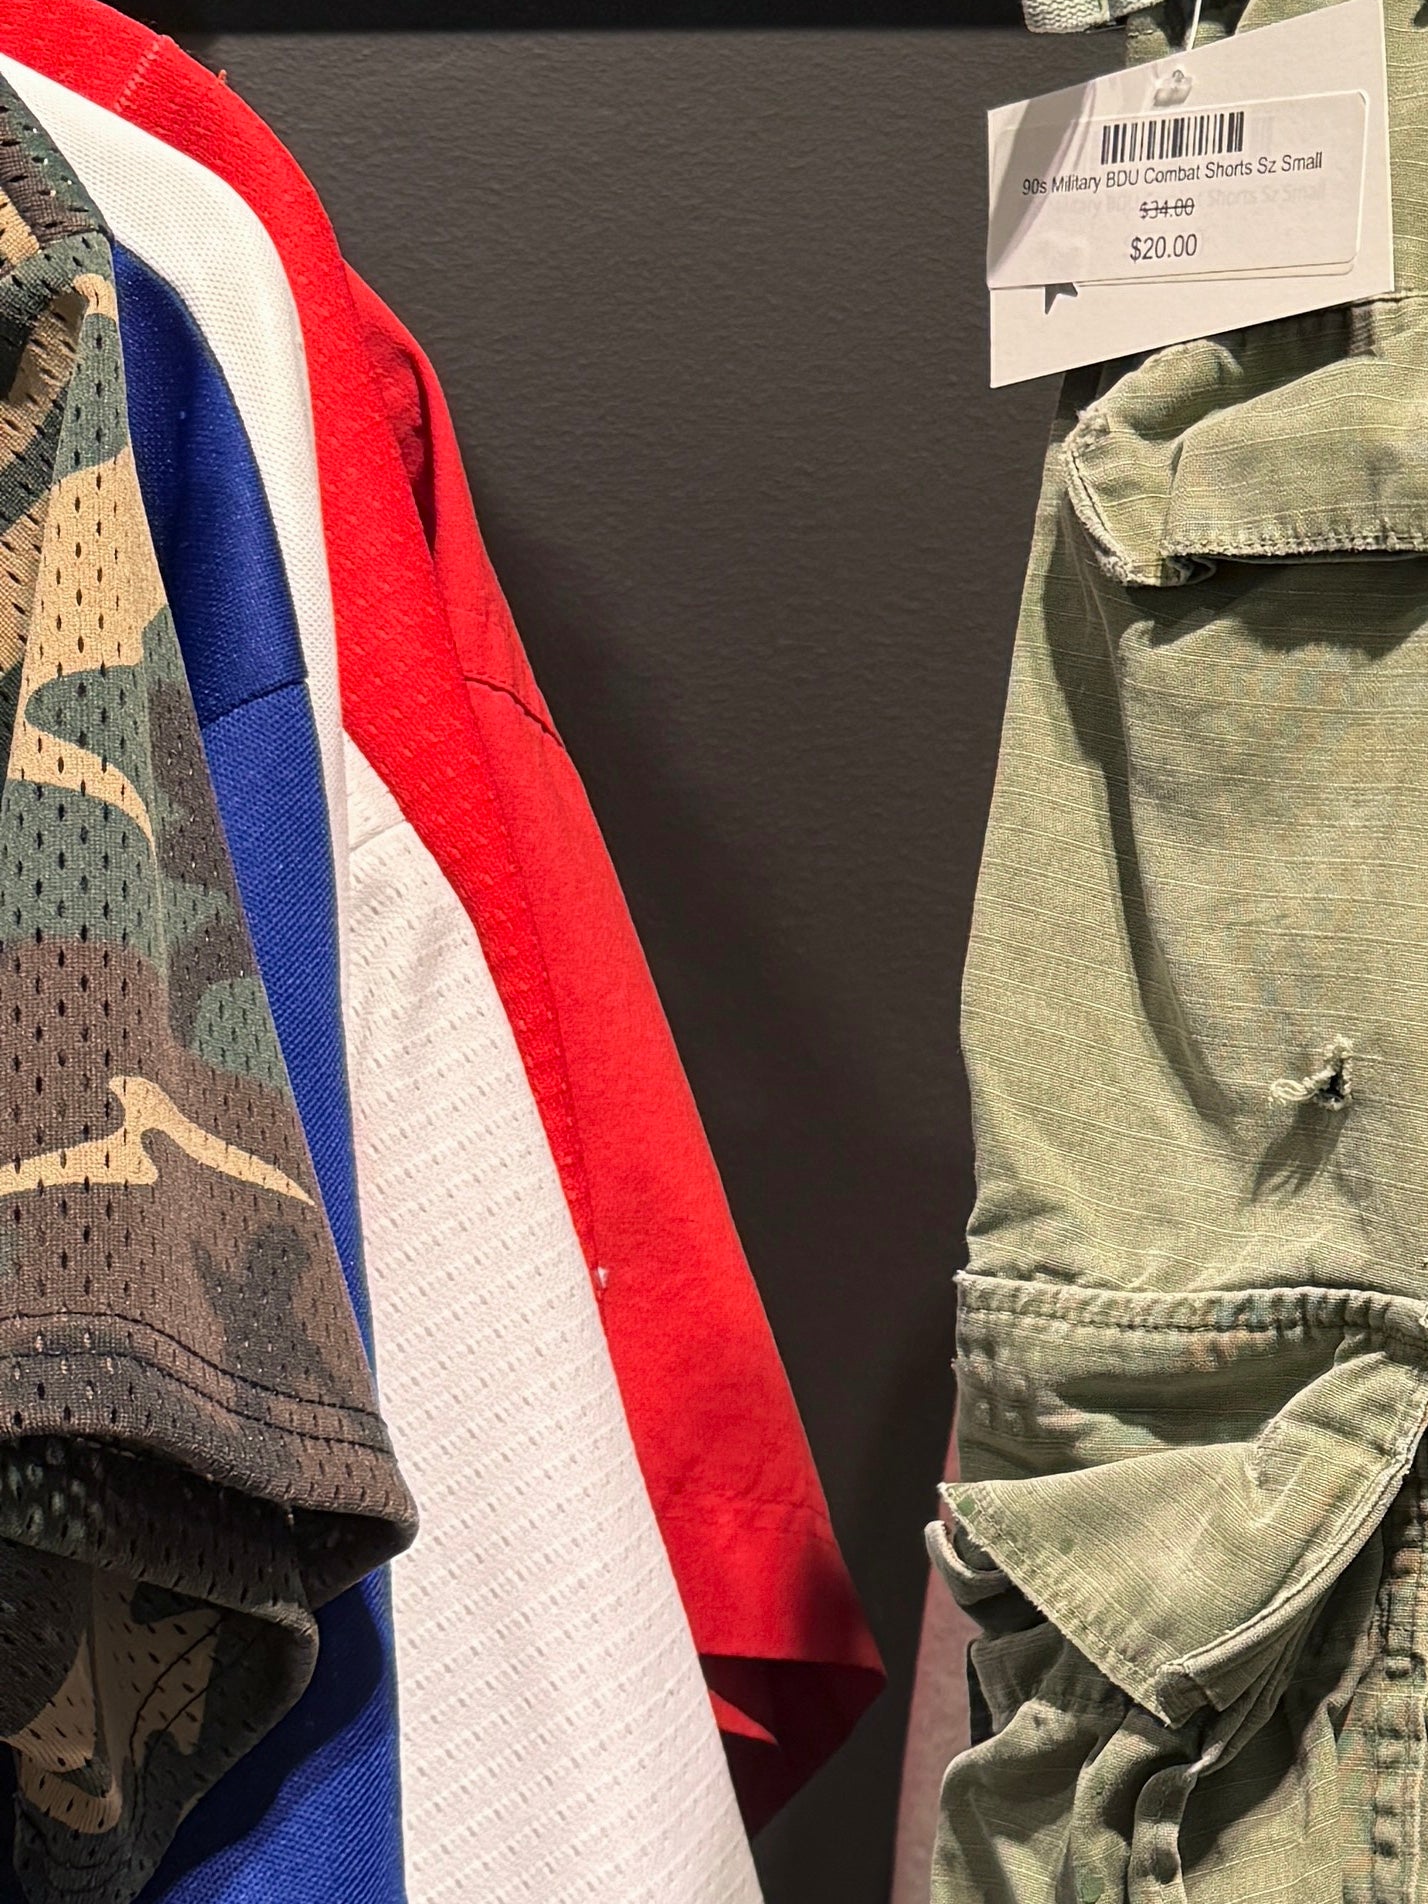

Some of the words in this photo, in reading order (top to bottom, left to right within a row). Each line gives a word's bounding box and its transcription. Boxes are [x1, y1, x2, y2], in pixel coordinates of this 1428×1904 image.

[1022, 178, 1047, 195] 90s
[1052, 174, 1101, 194] Military
[1106, 168, 1139, 188] BDU
[1144, 164, 1200, 184] Combat
[1205, 160, 1253, 179] Shorts
[1257, 156, 1277, 174] Sz
[1281, 151, 1323, 172] Small
[1139, 197, 1195, 220] $34.00
[1130, 233, 1198, 264] $20.00
